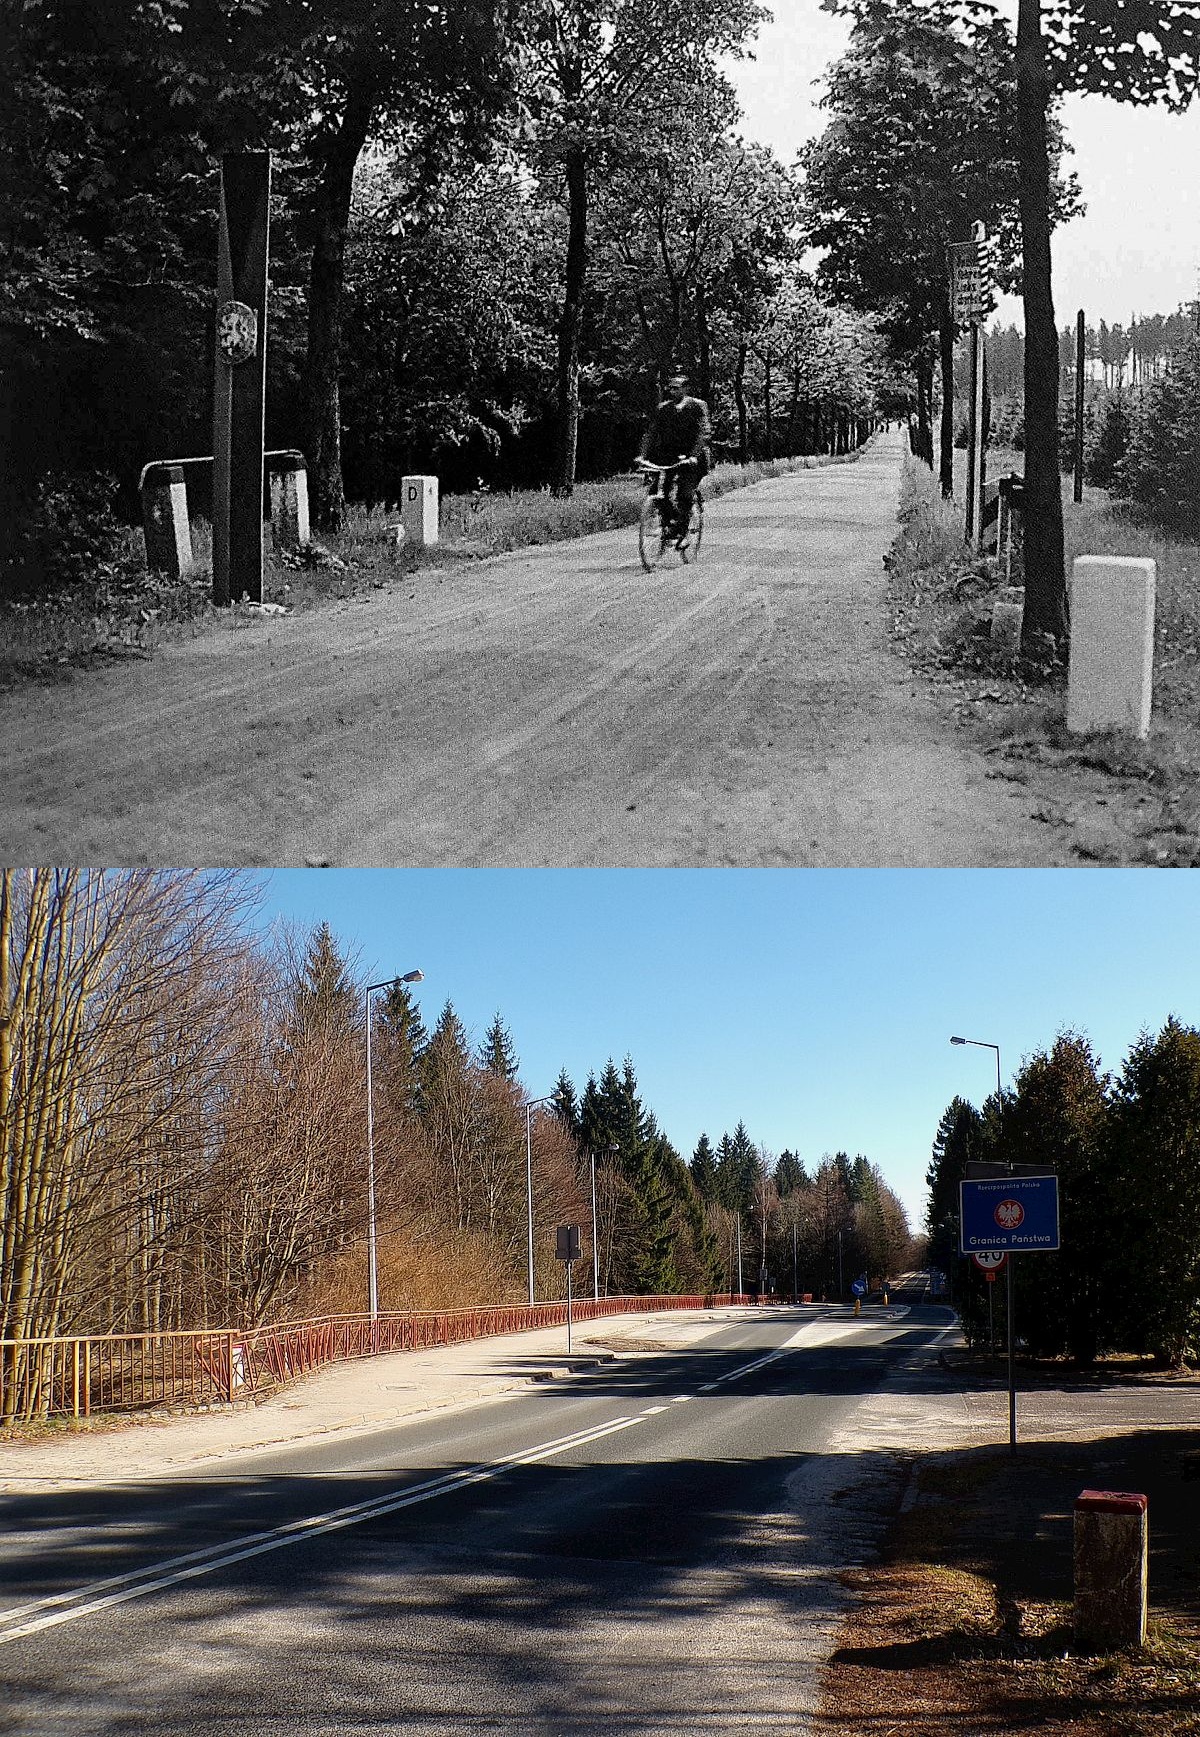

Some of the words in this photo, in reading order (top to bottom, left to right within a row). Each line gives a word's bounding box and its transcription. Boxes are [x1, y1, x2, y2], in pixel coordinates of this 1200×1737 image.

[409, 487, 417, 501] D
[969, 1236, 1007, 1245] Granica
[1011, 1234, 1051, 1244] Państwa
